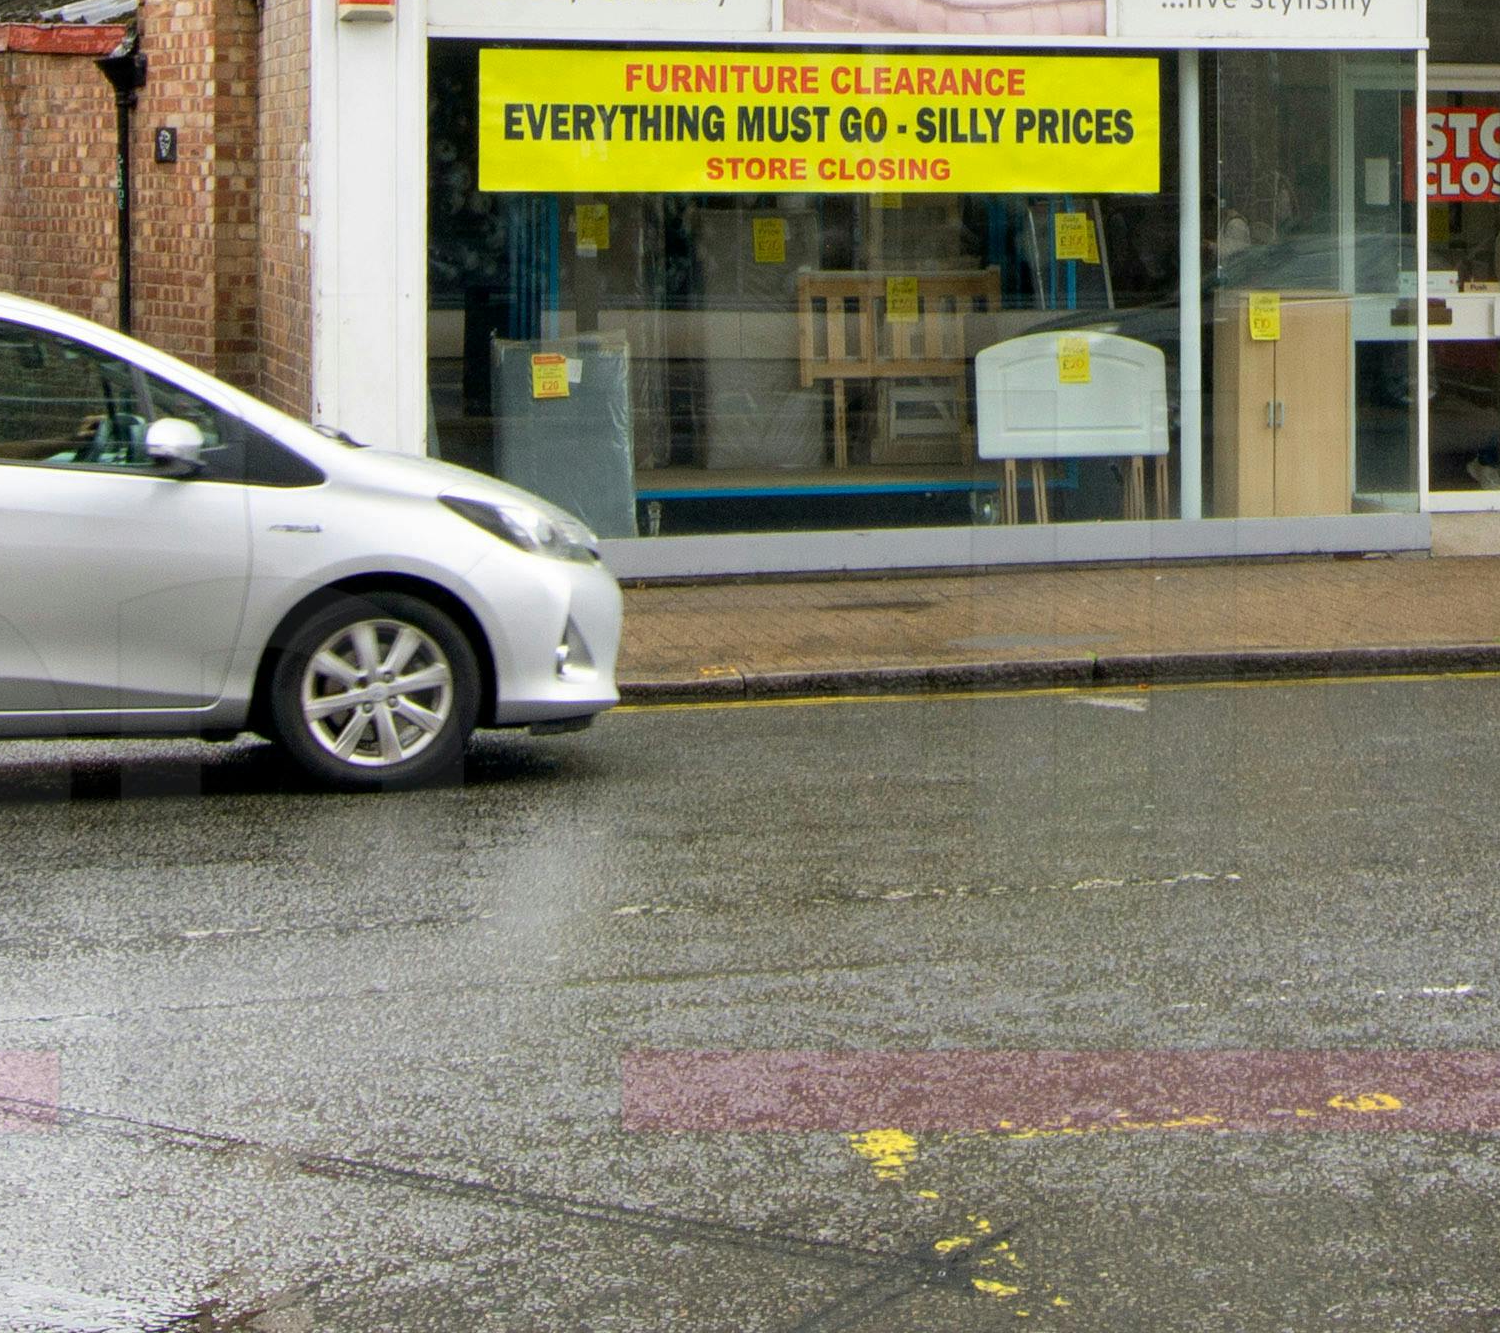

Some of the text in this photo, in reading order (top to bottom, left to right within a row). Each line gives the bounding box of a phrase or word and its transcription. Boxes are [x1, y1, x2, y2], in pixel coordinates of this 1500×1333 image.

[626, 64, 1025, 97] FURNITURE CLEARANCE
[504, 104, 726, 143] EVERYTHING
[737, 106, 830, 144] MUST
[840, 106, 887, 144] GO
[916, 108, 1006, 145] SILLY
[1016, 108, 1134, 145] PRICES
[707, 158, 951, 183] STORE CLOSING
[541, 380, 560, 391] £20
